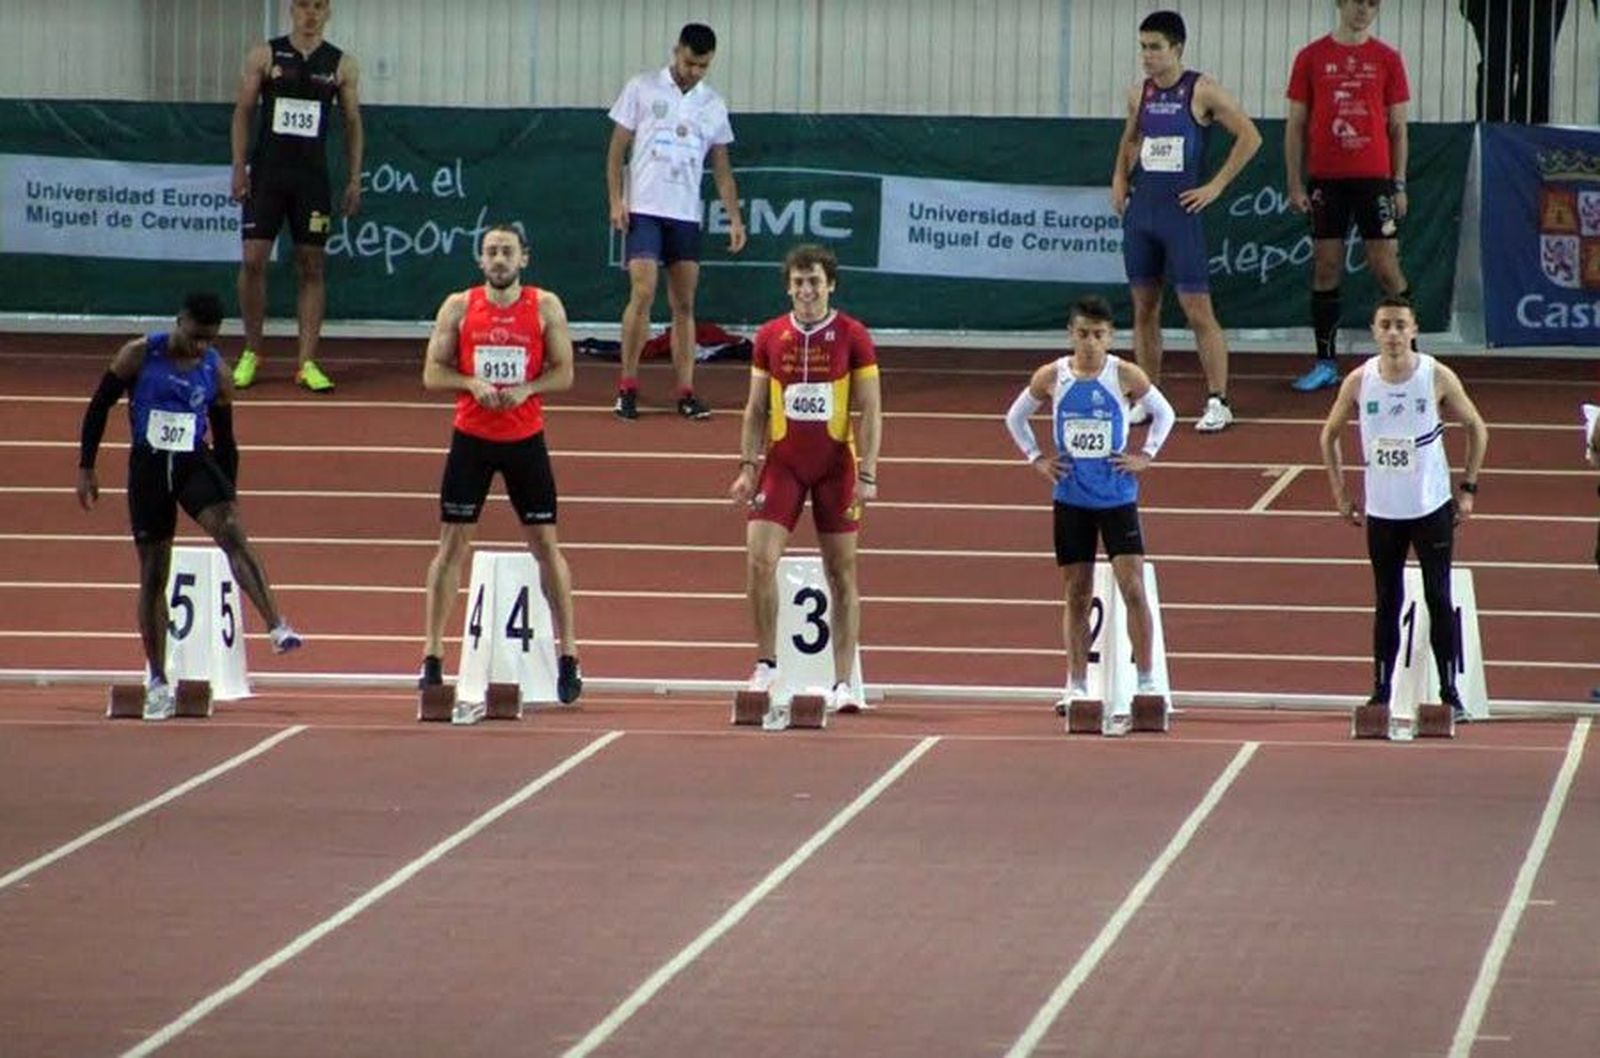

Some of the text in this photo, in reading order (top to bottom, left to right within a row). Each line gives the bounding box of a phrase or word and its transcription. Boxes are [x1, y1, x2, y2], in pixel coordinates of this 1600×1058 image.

[282, 111, 313, 129] 3135
[432, 158, 465, 197] el
[27, 181, 238, 211] Universidad Europe
[27, 205, 239, 231] Miguel de Cervante
[699, 198, 854, 238] EMC
[908, 202, 1125, 232] Universidad Europe
[324, 206, 527, 275] deport
[908, 226, 979, 249] Miguel
[987, 232, 1013, 249] de
[483, 362, 516, 378] 9131
[792, 397, 826, 413] 4062
[160, 425, 186, 443] 307
[1071, 433, 1105, 450] 4023
[1377, 449, 1409, 467] 2158
[168, 573, 195, 640] 5
[221, 581, 235, 648] 5
[469, 583, 484, 650] 4
[506, 586, 534, 652] 4
[792, 586, 829, 655] 3
[1087, 597, 1104, 663] 2
[1403, 601, 1416, 668] 1
